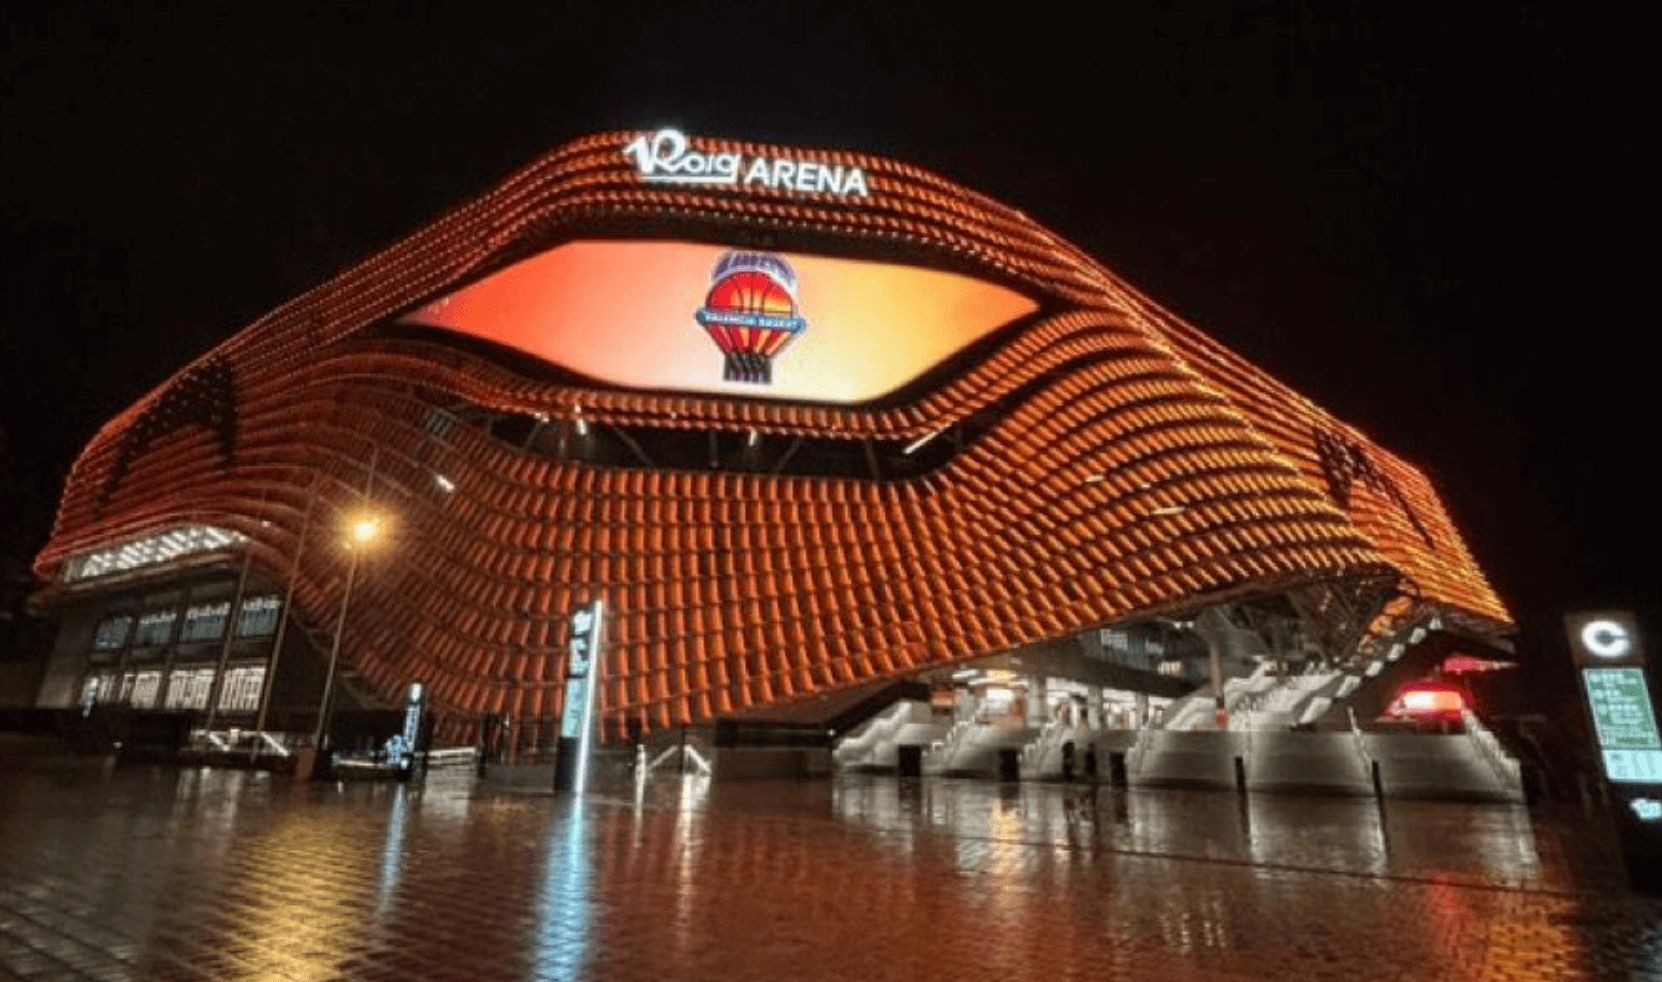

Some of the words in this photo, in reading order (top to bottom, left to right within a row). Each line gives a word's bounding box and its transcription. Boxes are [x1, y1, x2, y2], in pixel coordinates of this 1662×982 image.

[622, 128, 741, 184] Roig
[744, 157, 867, 196] ARENA
[1581, 620, 1629, 657] C
